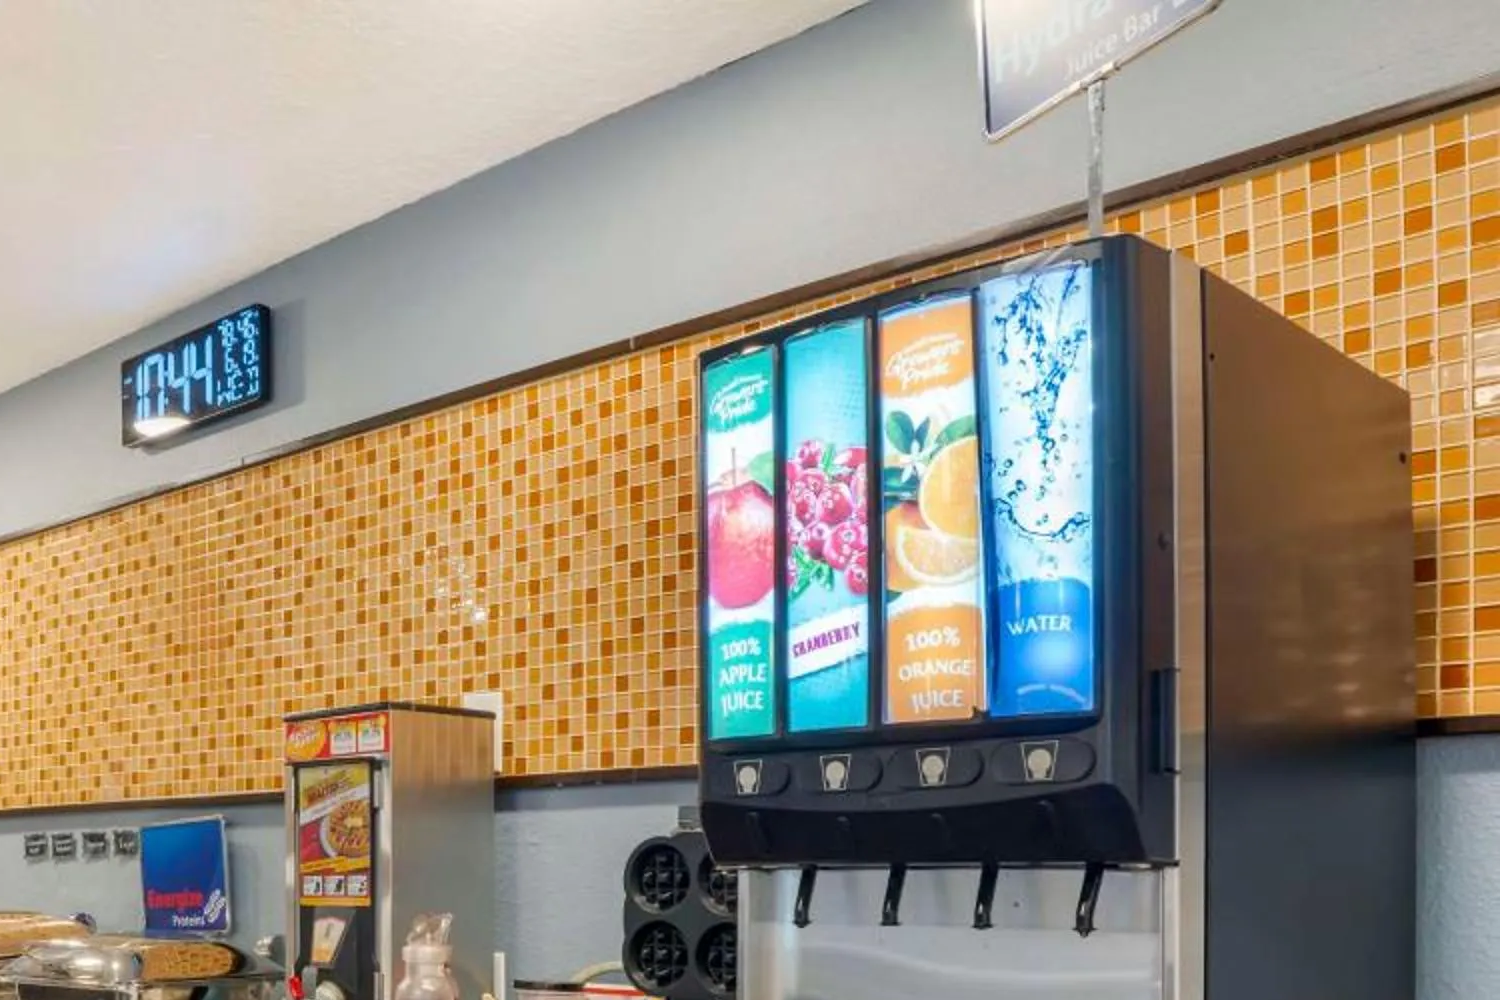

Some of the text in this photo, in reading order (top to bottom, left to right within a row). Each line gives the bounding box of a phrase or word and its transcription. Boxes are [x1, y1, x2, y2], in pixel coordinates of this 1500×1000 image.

[1064, 4, 1163, 81] Juice Bar
[1006, 614, 1072, 637] WATER
[721, 637, 761, 661] 100%
[793, 622, 860, 658] CRANBERRY
[905, 625, 961, 652] 100%
[719, 662, 767, 687] APPLE
[899, 658, 974, 682] ORANGE
[721, 690, 764, 718] JUICE
[912, 689, 964, 714] JUICE
